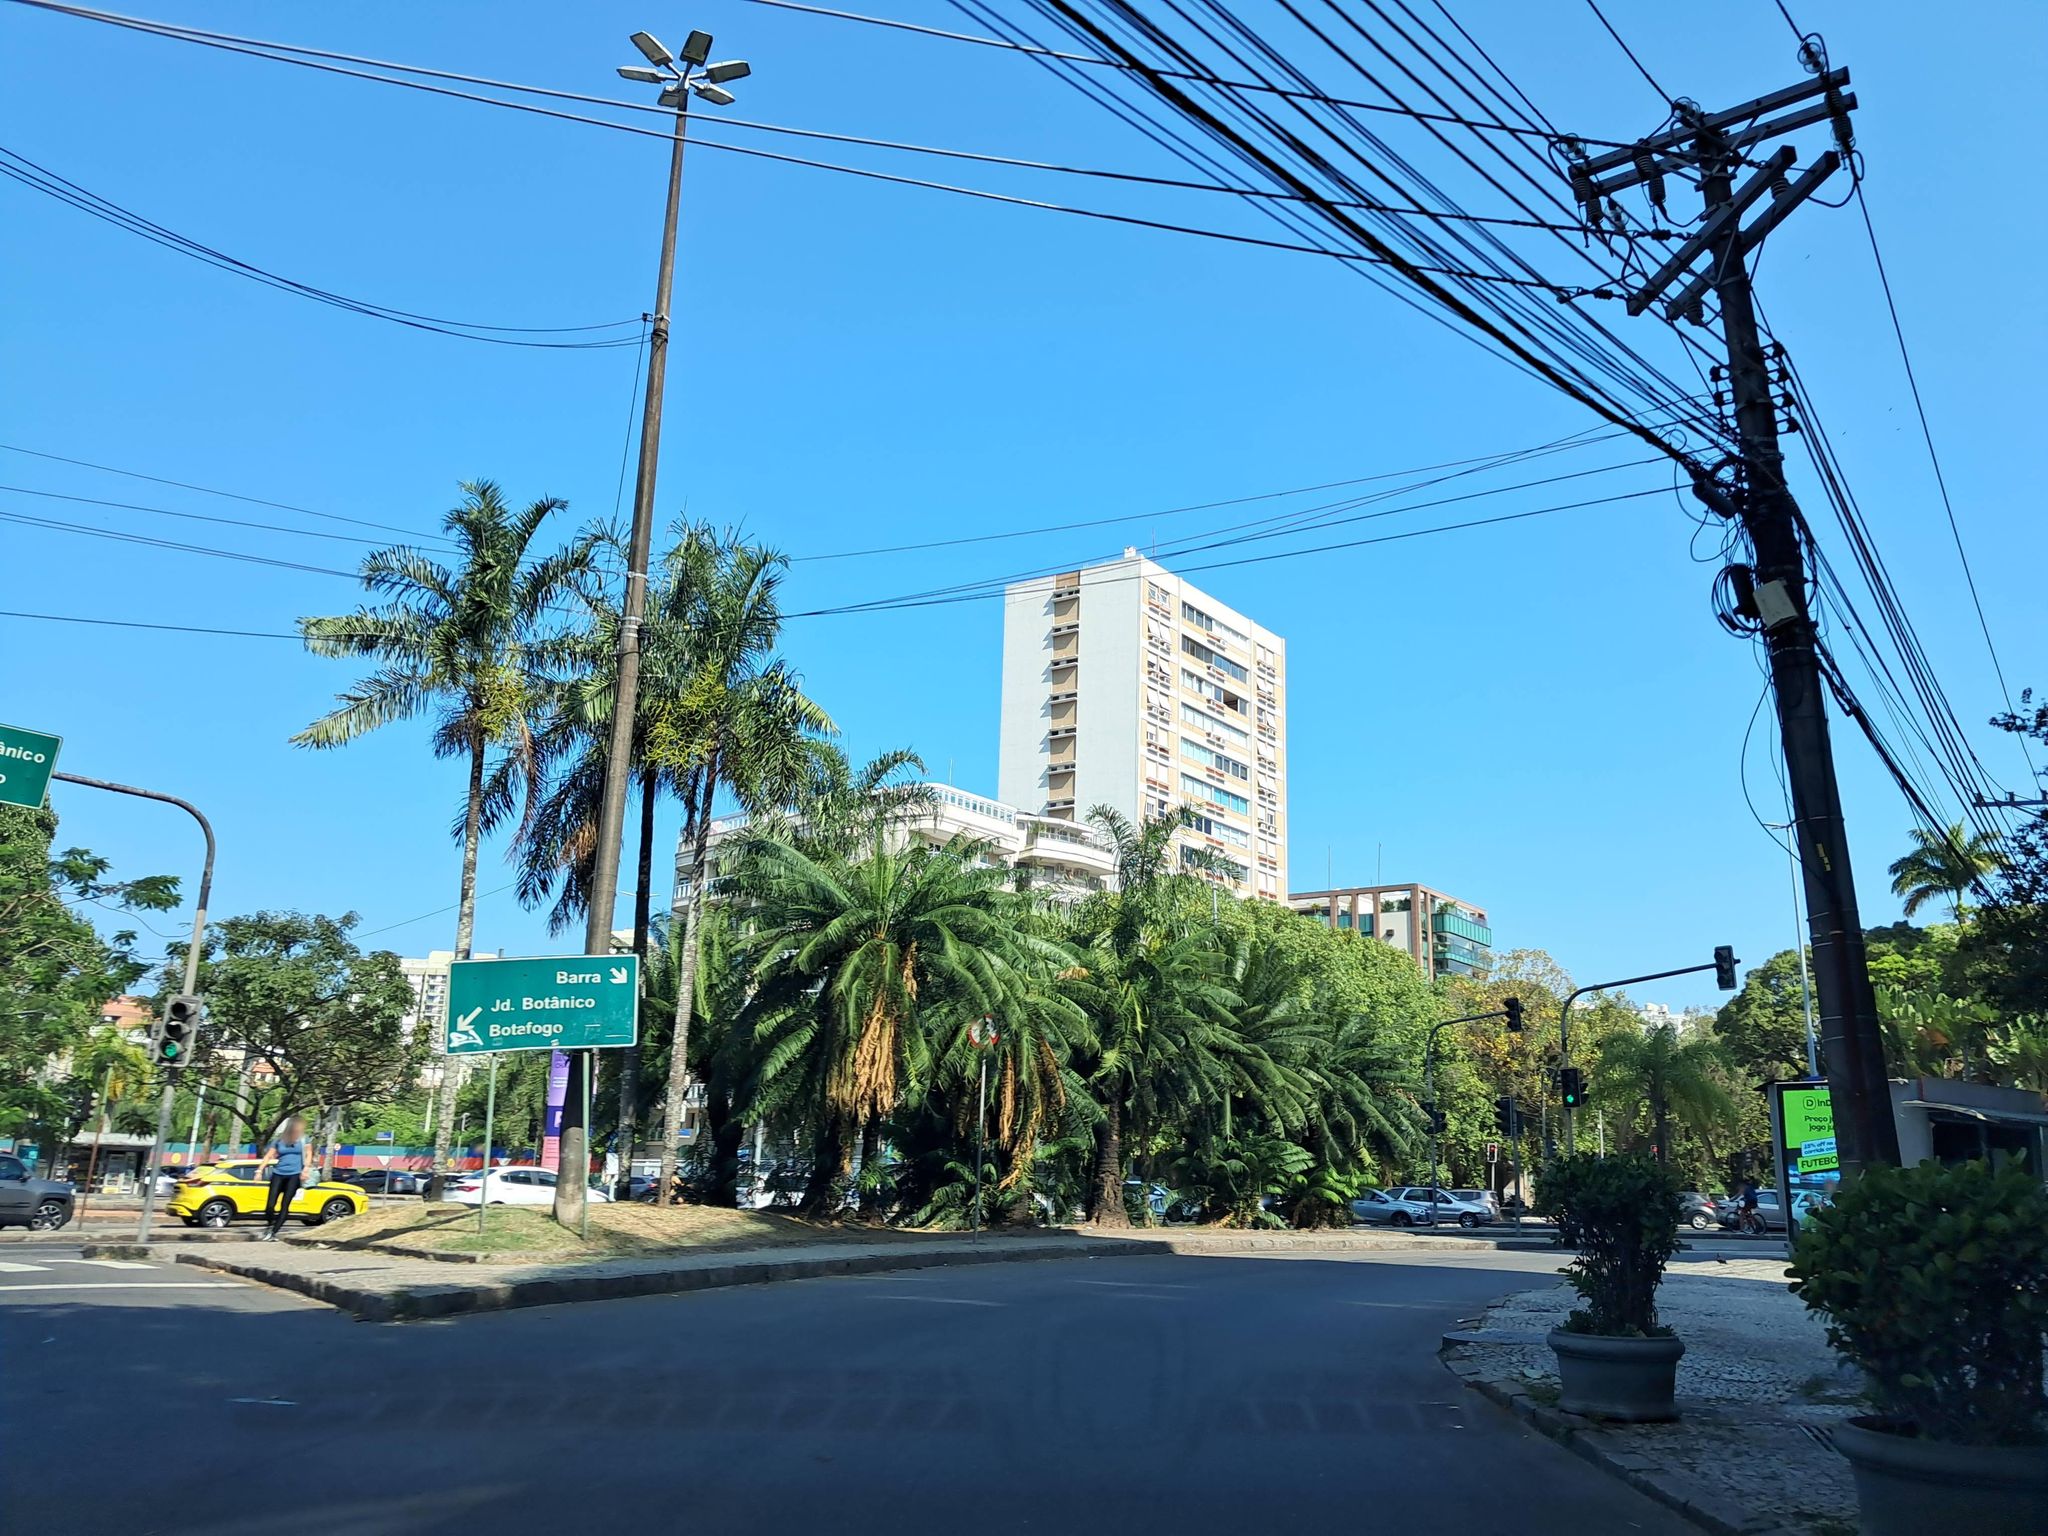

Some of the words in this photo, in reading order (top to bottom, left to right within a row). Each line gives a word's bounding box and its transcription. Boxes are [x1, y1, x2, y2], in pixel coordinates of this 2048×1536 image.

[556, 971, 601, 984] Barra
[490, 999, 515, 1012] Jd.
[522, 996, 596, 1010] Botânico
[489, 1022, 564, 1037] Botafogo
[1804, 1115, 1828, 1123] Preço
